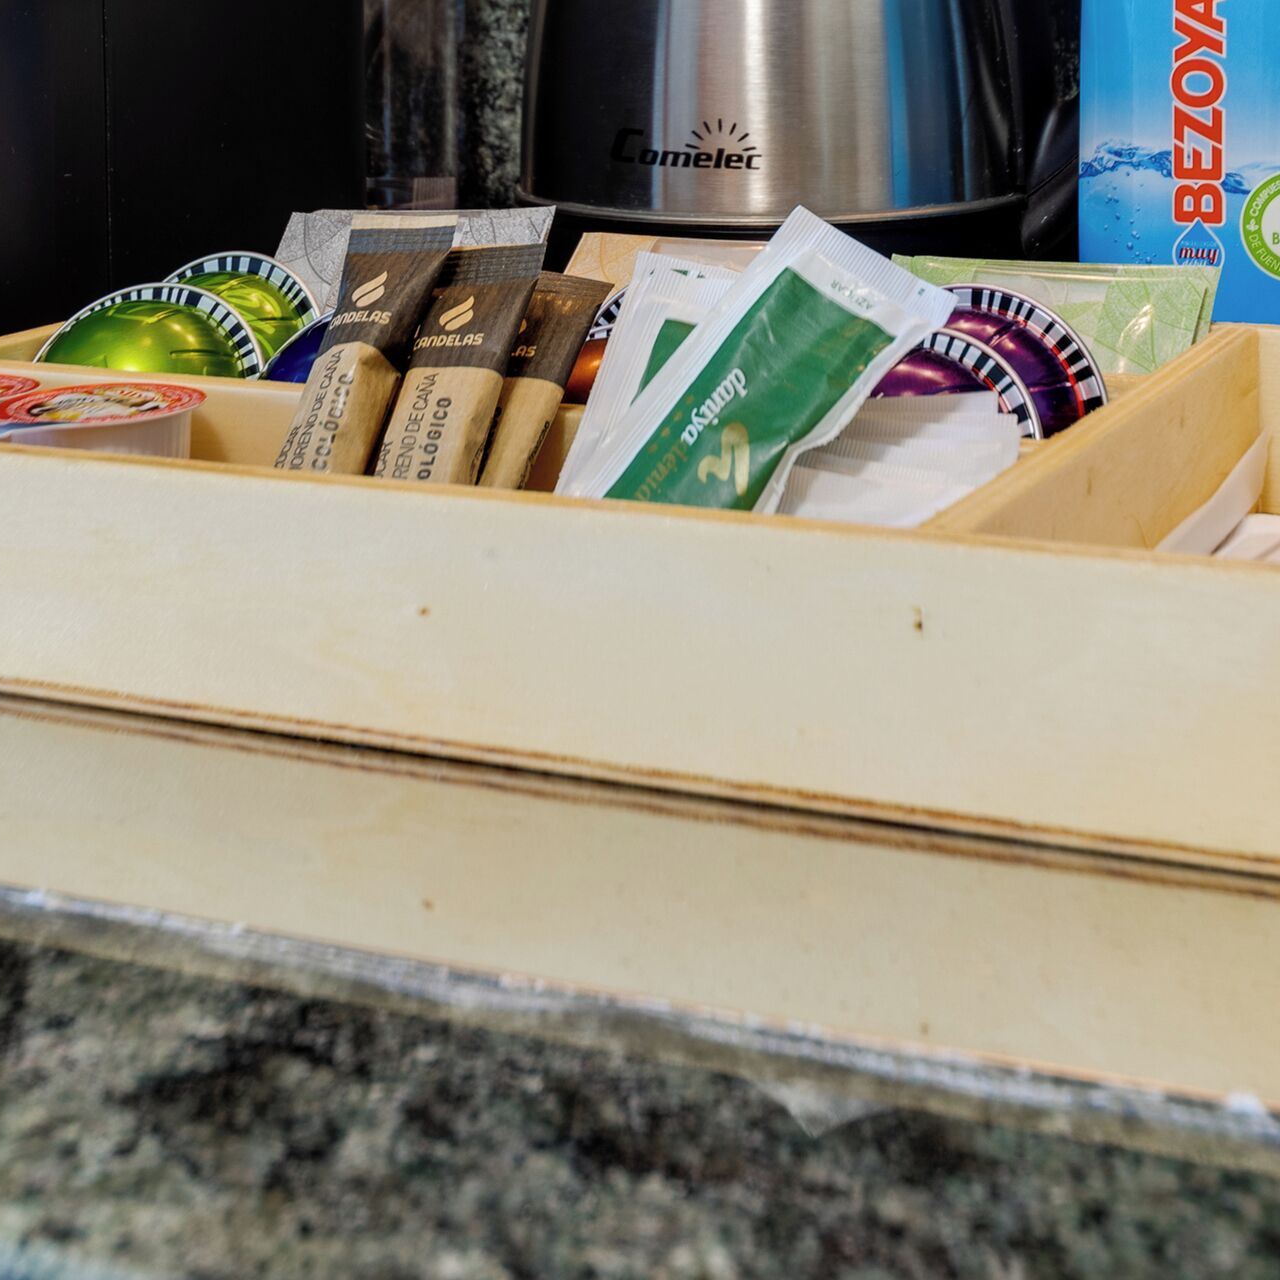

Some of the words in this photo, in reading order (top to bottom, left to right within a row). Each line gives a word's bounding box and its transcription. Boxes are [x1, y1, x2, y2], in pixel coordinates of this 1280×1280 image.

[610, 126, 763, 170] Comelec
[1249, 234, 1261, 249] DE
[1179, 247, 1219, 265] muy
[328, 310, 392, 330] CANDELAS
[413, 332, 484, 351] CANDELAS
[412, 372, 440, 410] CAÑA
